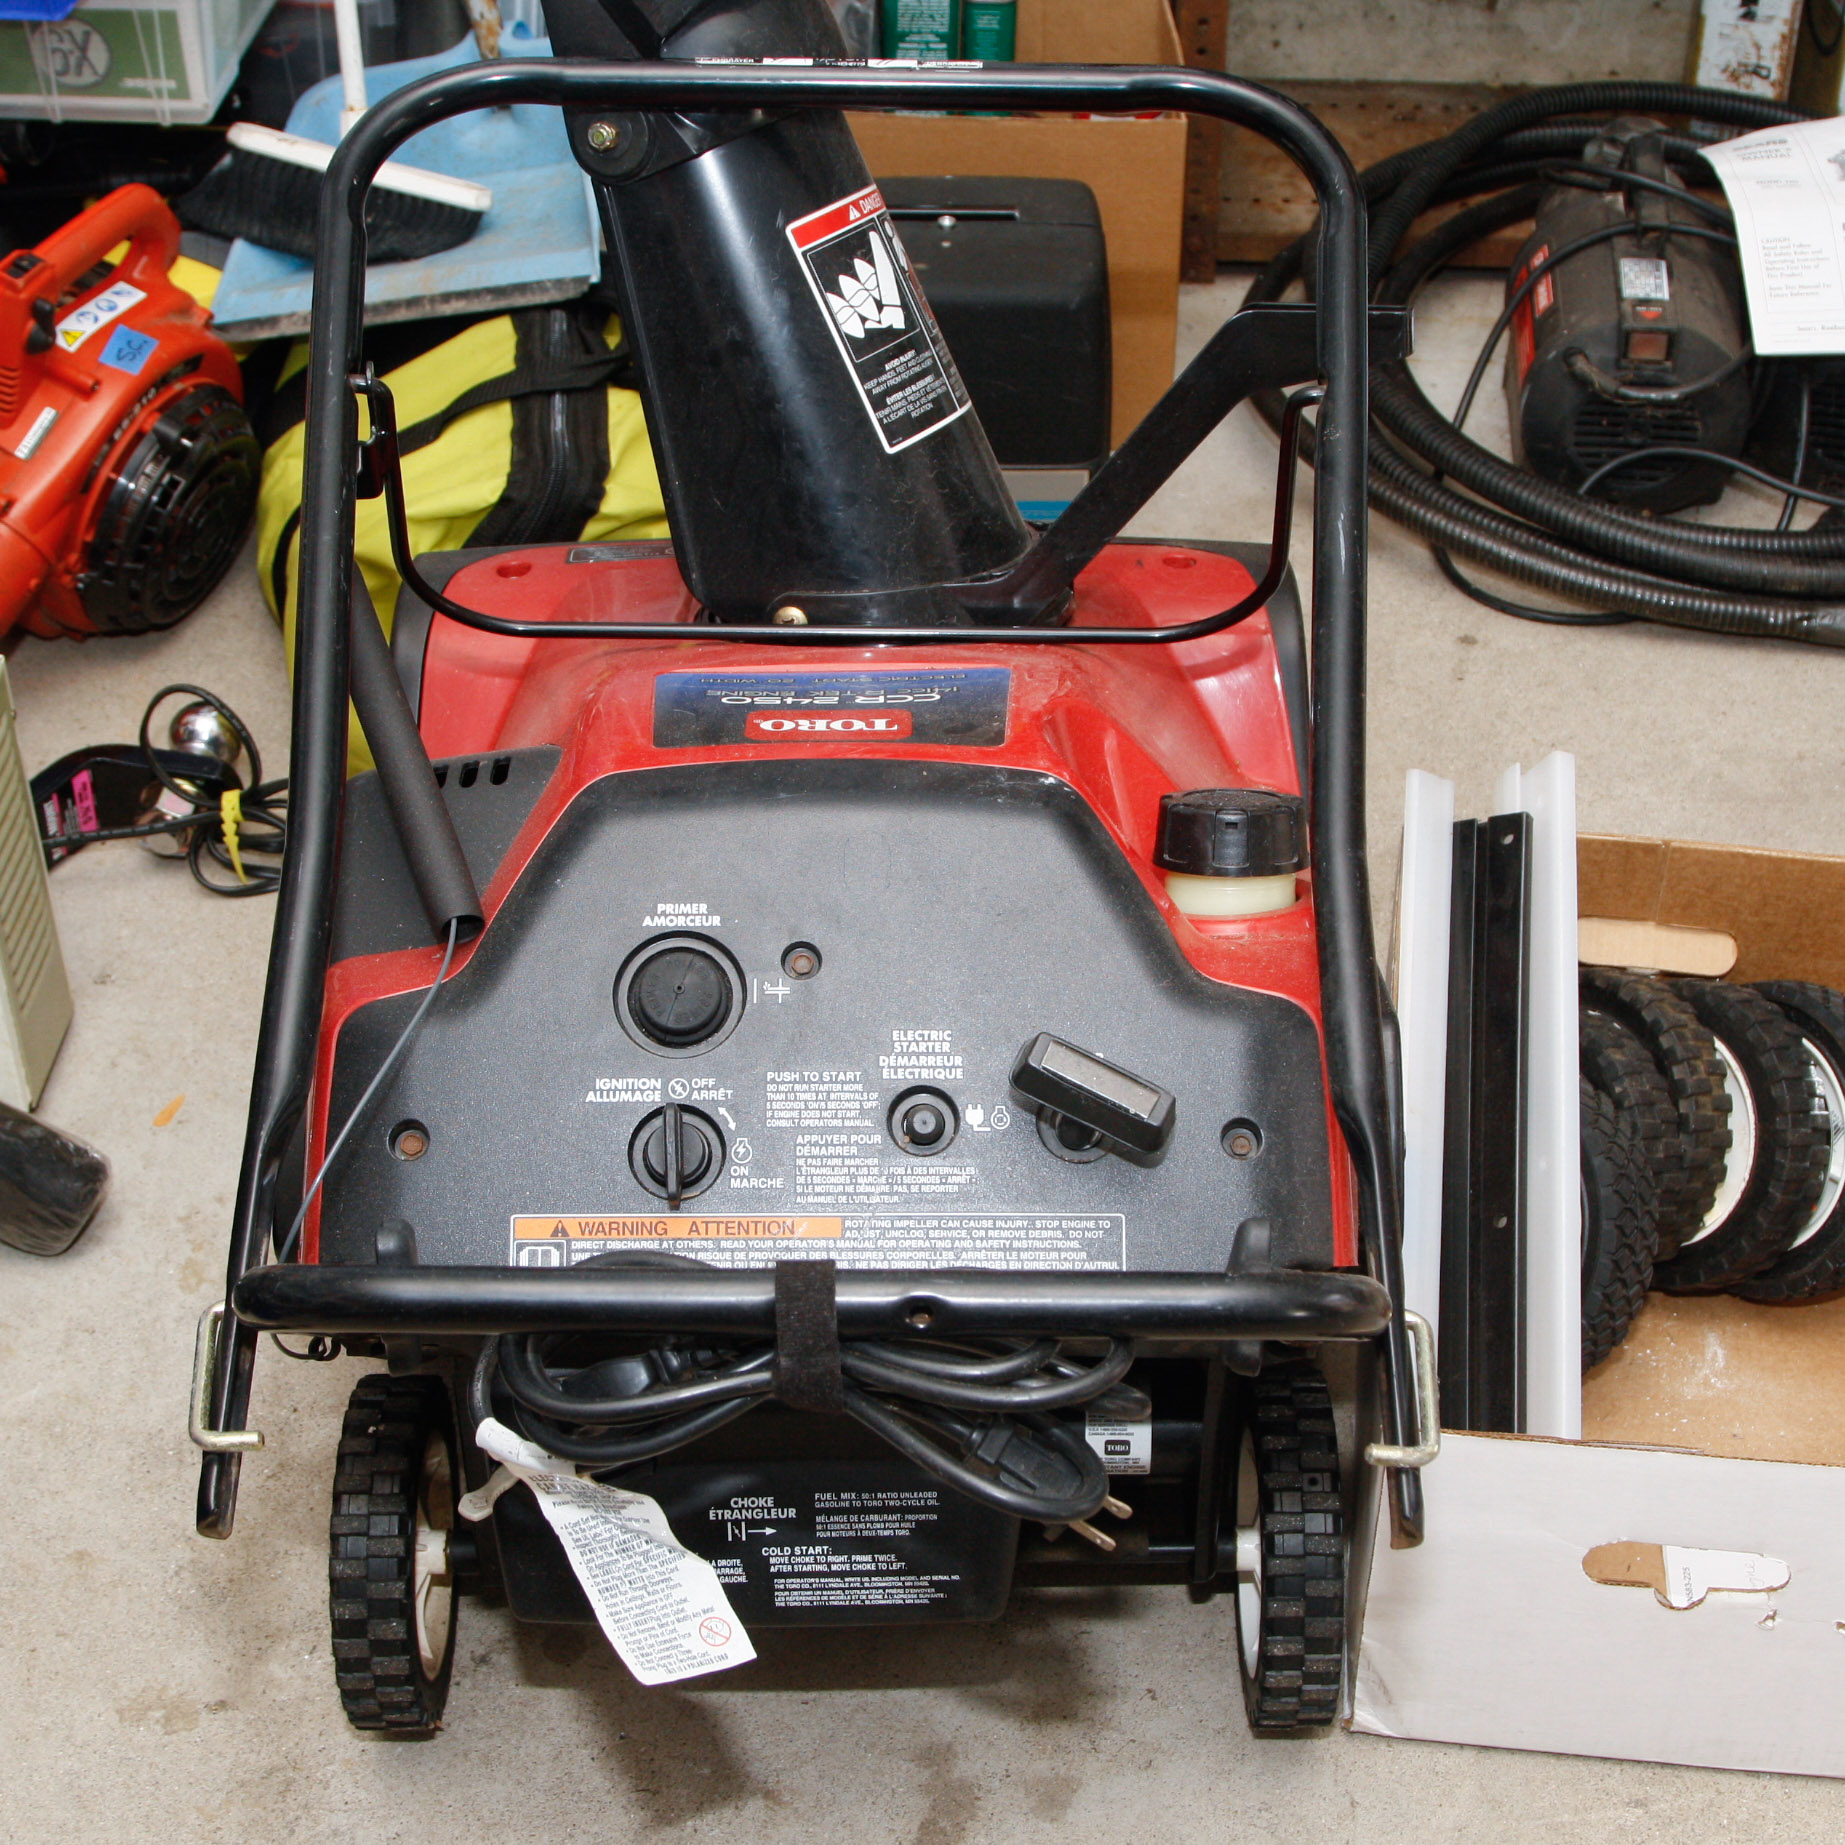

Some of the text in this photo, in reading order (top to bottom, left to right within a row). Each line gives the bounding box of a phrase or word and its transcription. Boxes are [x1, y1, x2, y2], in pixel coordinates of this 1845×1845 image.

[722, 694, 940, 704] CCR 2450
[759, 719, 897, 731] TORO
[657, 904, 708, 914] PRIMER
[642, 916, 721, 927] AMORCEUR
[892, 1030, 951, 1040] ELECTRIC
[894, 1042, 950, 1052] STARTER
[879, 1053, 963, 1066] DÉMARREUR
[767, 1072, 861, 1081] PUSH TO START
[882, 1066, 963, 1080] ÉLECTRIQUE
[596, 1079, 662, 1090] IGNITION
[692, 1079, 716, 1088] OFF
[586, 1091, 662, 1102] ALLUMAGE
[692, 1088, 733, 1100] ARRÊT
[767, 1101, 860, 1109] 5 SECONDS SECONDS
[766, 1110, 861, 1118] IF ENGINE DOES NOT START,
[766, 1119, 874, 1127] CONSULT OPERATORS MANUAL.
[796, 1134, 881, 1144] APPUYER POUR
[796, 1145, 858, 1156] DÉMARRER
[731, 1166, 749, 1176] ON
[731, 1178, 784, 1188] MARCHE
[578, 1221, 795, 1236] WARNING ATTENTION
[894, 1220, 1110, 1228] IMPELLER CAN CAUSE STOP ENGINE TO
[887, 1230, 1104, 1239] UNCLOG, OR REMOVE DEBRIS. DO NOT
[572, 1240, 1081, 1249] DIRECT DISCHARGE AT READ YOUR OPERATOR'S MANUAL FOR OPERATING AND SAFETY INSTRUCTIONS.
[698, 1252, 732, 1260] RISQUE
[735, 1252, 746, 1260] DE
[749, 1252, 806, 1260] PROVOQUER
[809, 1252, 827, 1260] DES
[830, 1252, 884, 1260] BLESSURES
[961, 1250, 1004, 1259] ARRÊTER
[856, 1261, 1072, 1269] NE PAS DIRIGER EN DIRECTION
[731, 1497, 775, 1509] CHOKE
[709, 1506, 796, 1521] ÉTRANGLEUR
[816, 1514, 848, 1522] MÉLANGE
[762, 1546, 832, 1556] COLD START:
[718, 1559, 743, 1567] DROITE,
[828, 1555, 850, 1563] RIGHT.
[875, 1554, 897, 1562] TWICE.
[770, 1564, 792, 1572] AFTER
[794, 1564, 829, 1573] STARTING,
[889, 1562, 907, 1570] LEFT.
